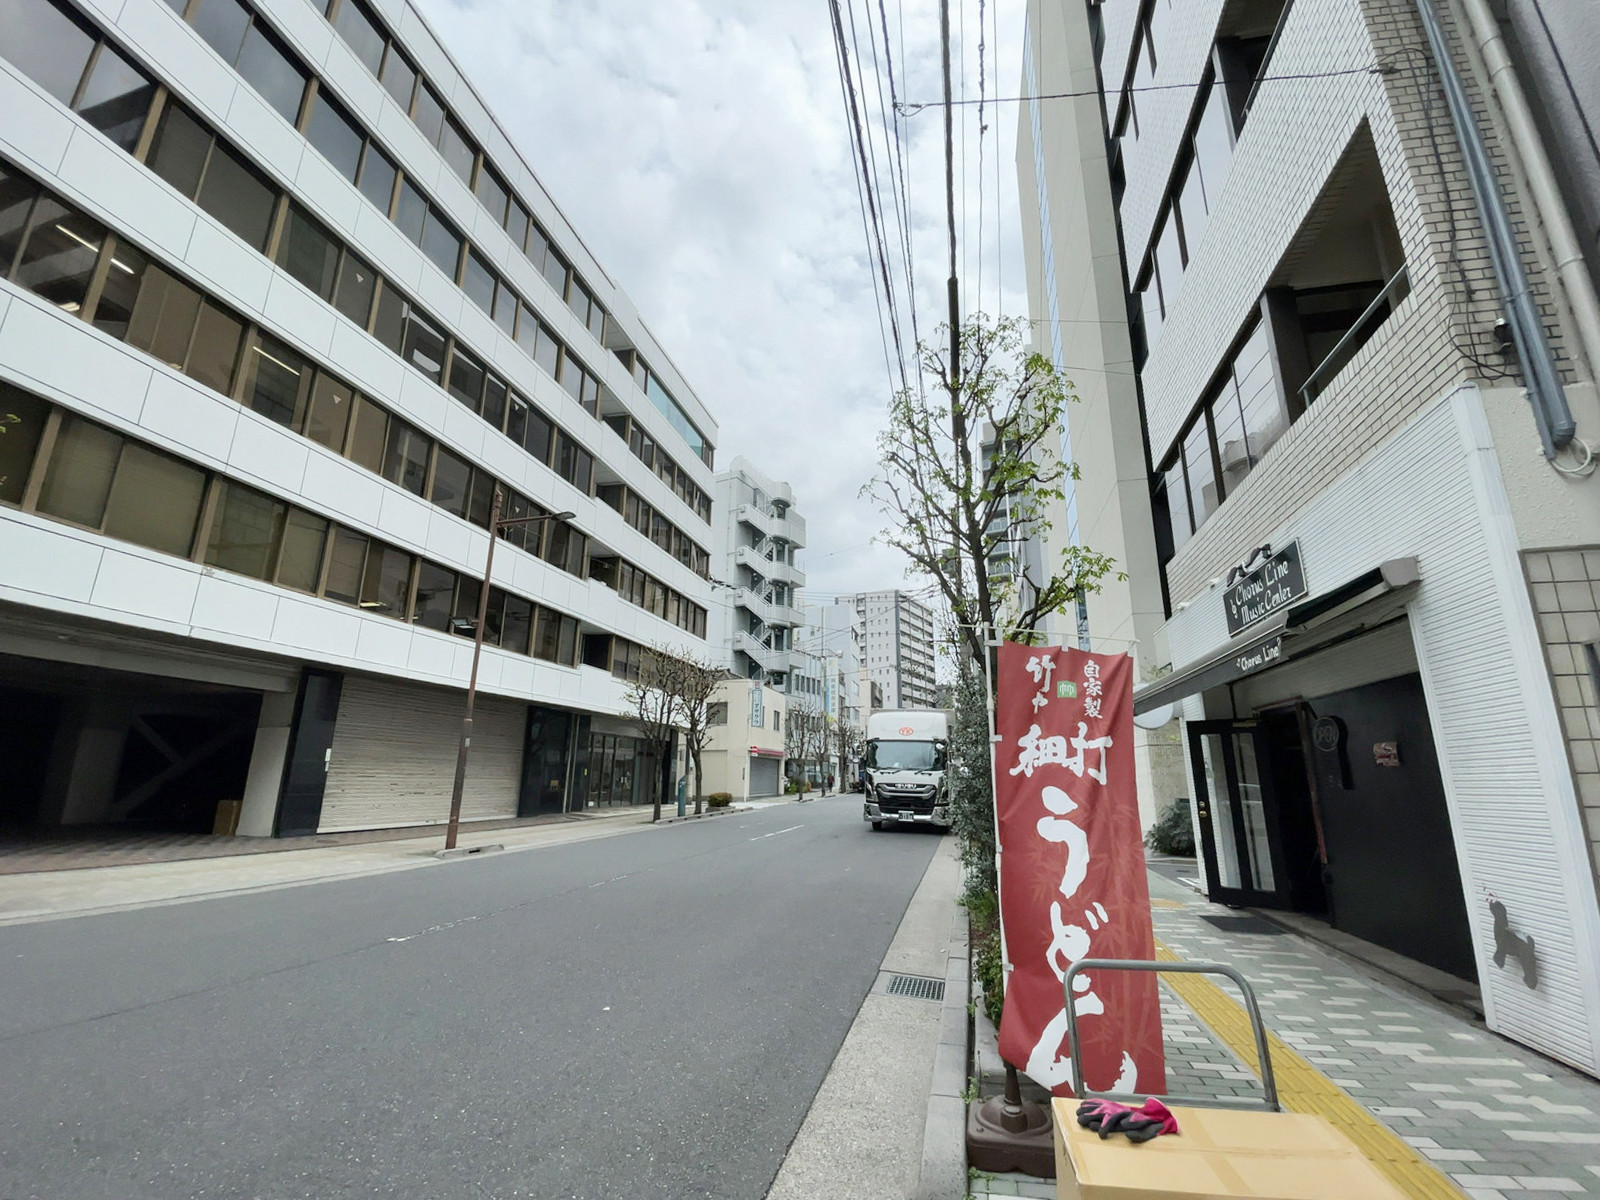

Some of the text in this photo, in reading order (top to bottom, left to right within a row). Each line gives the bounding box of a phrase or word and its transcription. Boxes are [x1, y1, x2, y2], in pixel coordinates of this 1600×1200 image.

[1235, 561, 1289, 606] Chorus Line
[1241, 583, 1292, 625] Music Center
[1025, 654, 1056, 714] 竹や
[1083, 659, 1104, 719] 自家製
